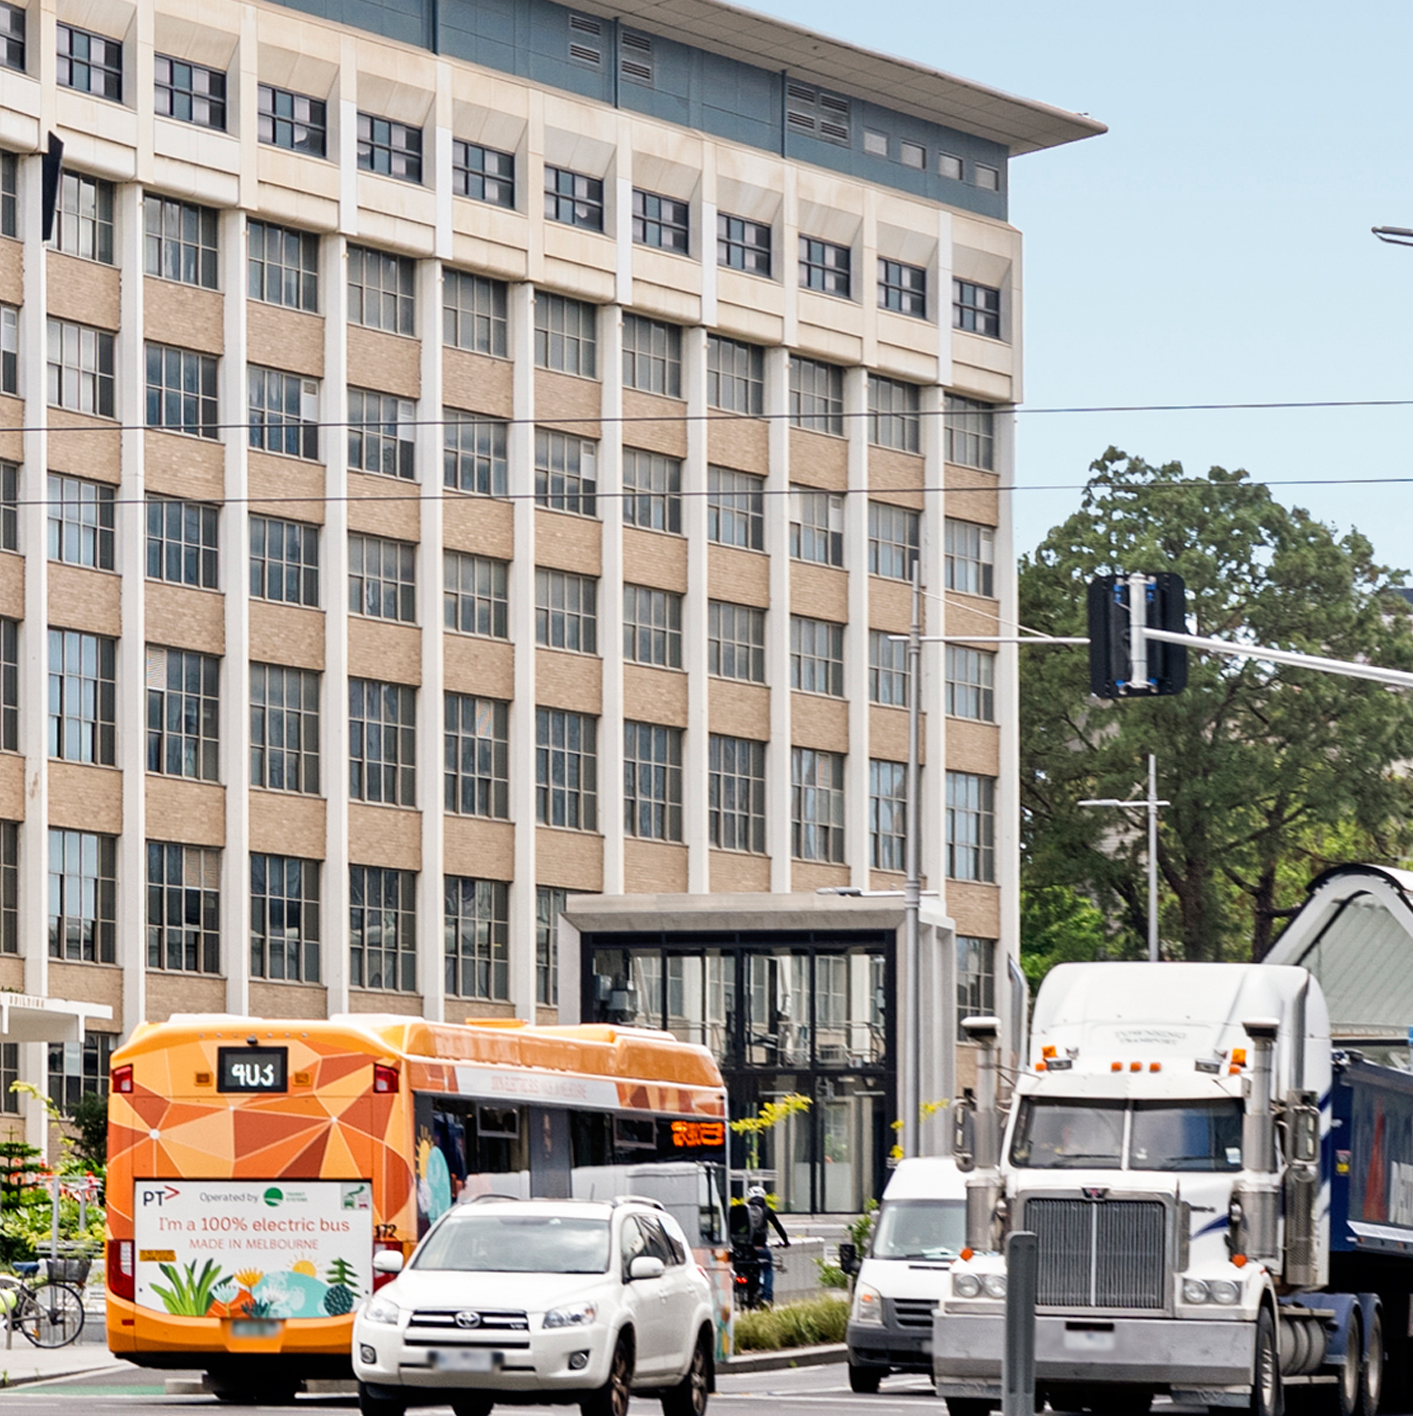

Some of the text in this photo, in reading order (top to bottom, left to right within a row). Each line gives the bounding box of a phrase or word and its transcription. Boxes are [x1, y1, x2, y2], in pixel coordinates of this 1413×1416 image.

[199, 1192, 245, 1203] Operated
[247, 1193, 259, 1203] by
[159, 1216, 350, 1232] I'm a 100% electric bus
[189, 1238, 319, 1250] MADE IN MELBOURNE
